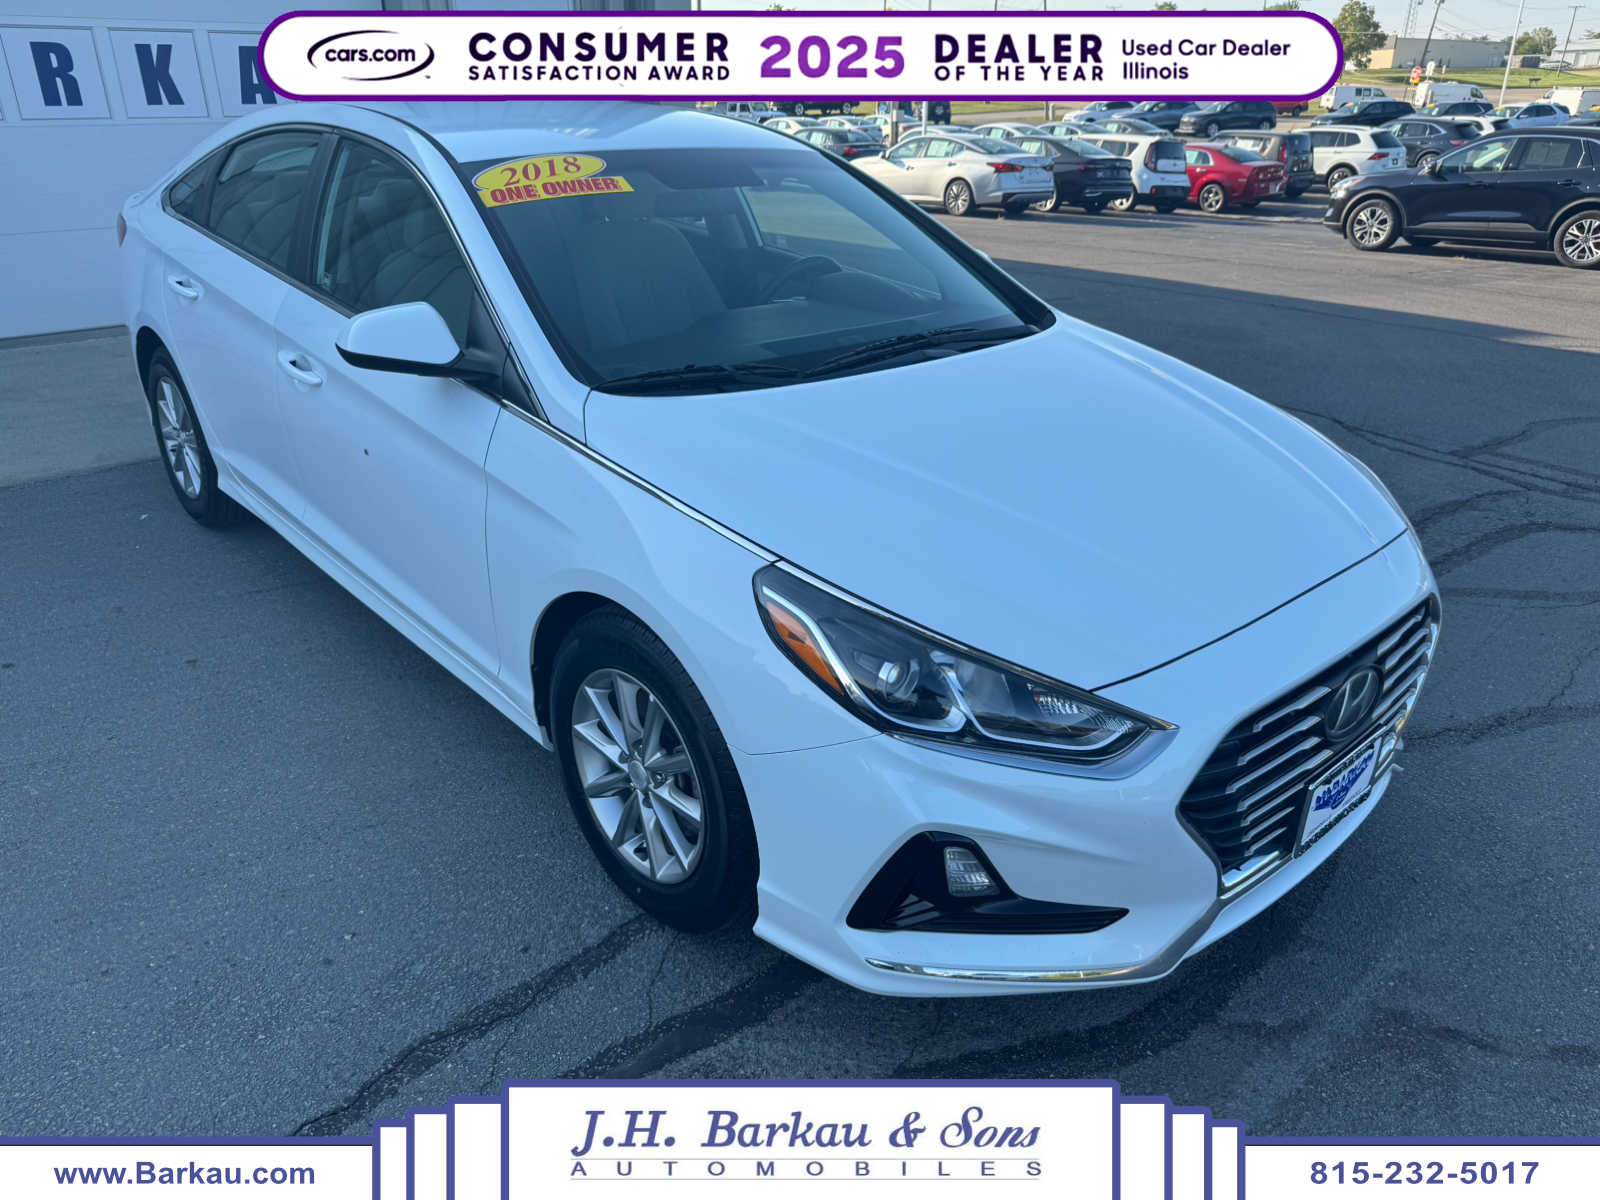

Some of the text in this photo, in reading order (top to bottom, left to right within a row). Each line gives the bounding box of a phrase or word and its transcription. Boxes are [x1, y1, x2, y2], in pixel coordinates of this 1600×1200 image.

[500, 155, 582, 188] 2018
[490, 177, 622, 205] ONE OWNER
